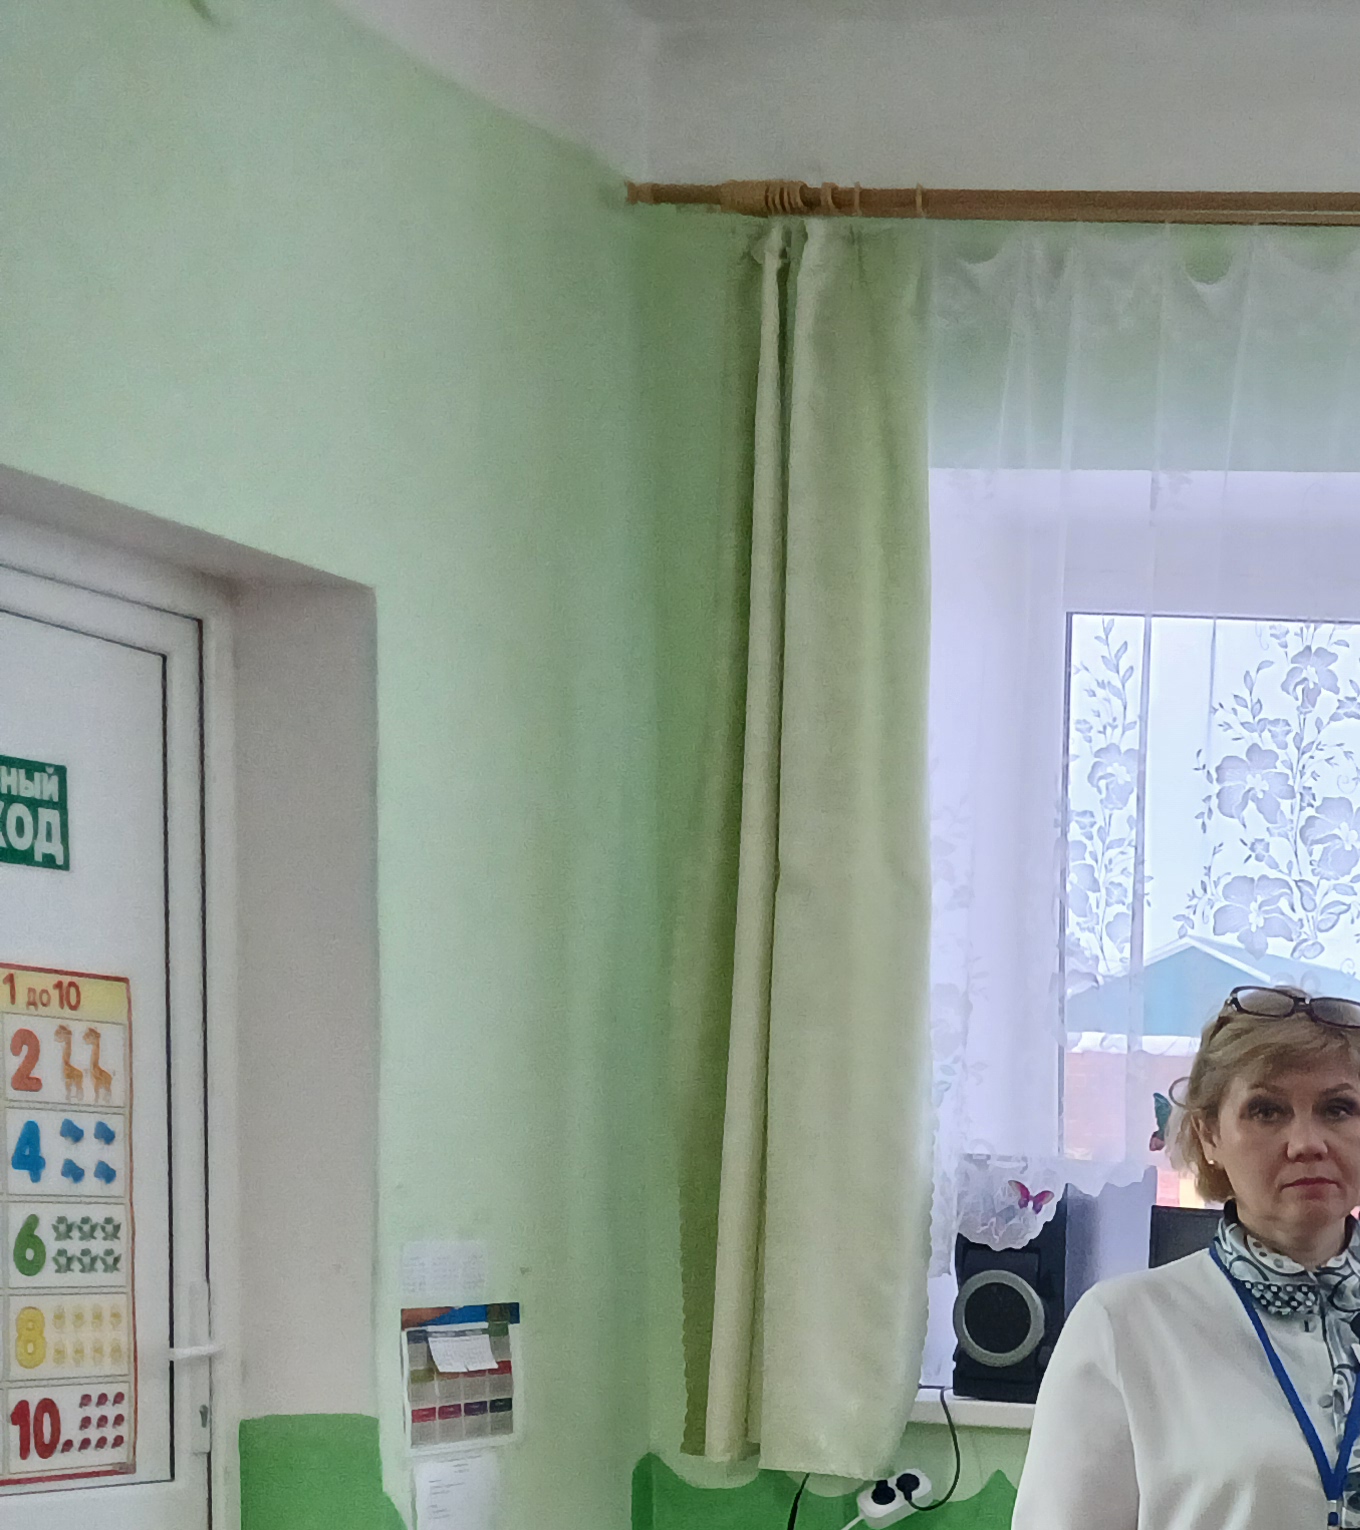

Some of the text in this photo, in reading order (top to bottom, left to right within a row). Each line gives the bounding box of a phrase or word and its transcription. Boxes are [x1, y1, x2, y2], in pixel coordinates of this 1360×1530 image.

[0, 802, 65, 866] ОД
[2, 972, 82, 1012] 1 до 10
[10, 1027, 43, 1092] 2
[11, 1120, 46, 1184] 4
[13, 1213, 46, 1277] 6
[15, 1306, 47, 1370] 8
[10, 1397, 62, 1461] 10
